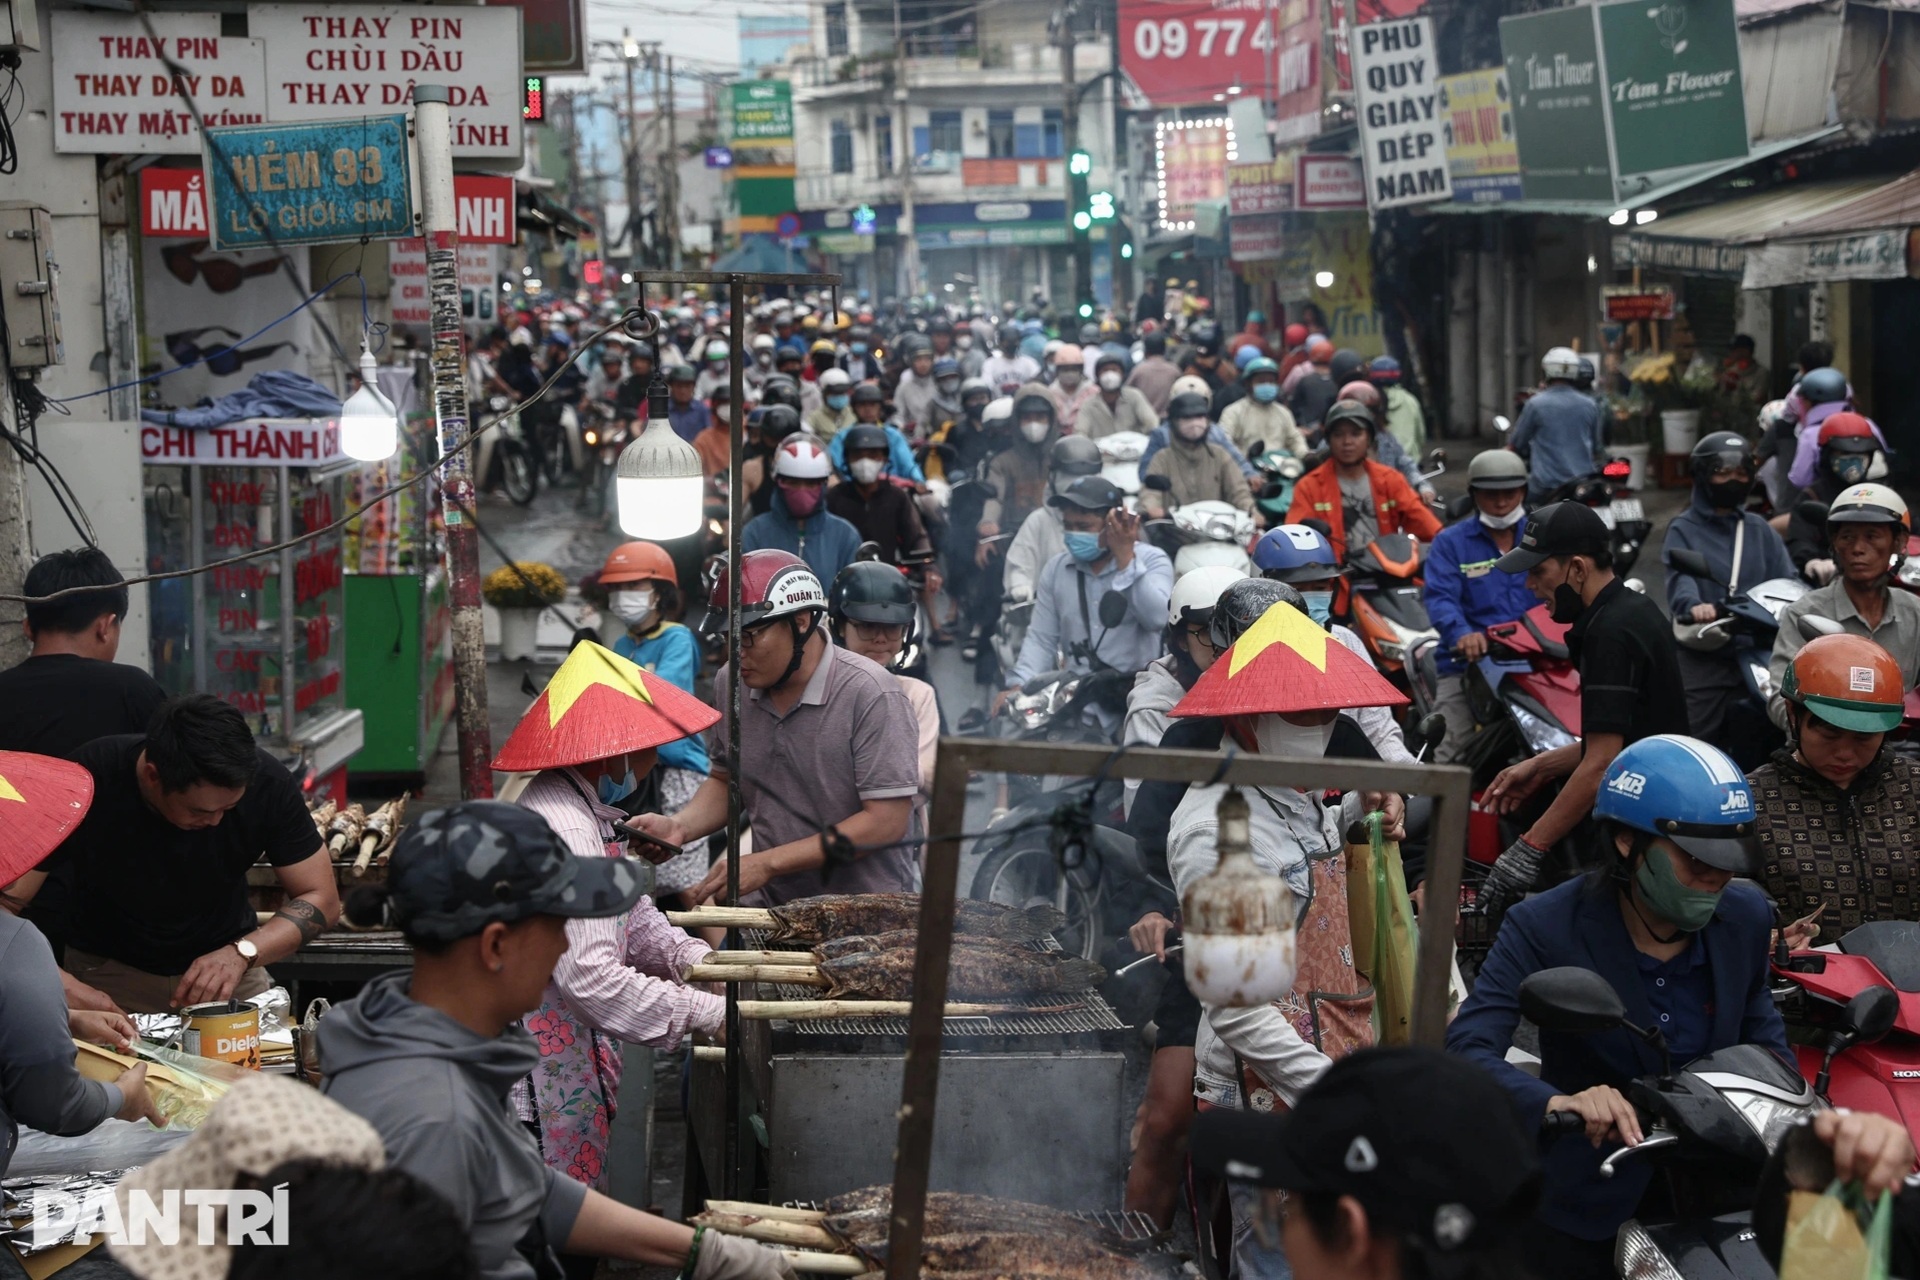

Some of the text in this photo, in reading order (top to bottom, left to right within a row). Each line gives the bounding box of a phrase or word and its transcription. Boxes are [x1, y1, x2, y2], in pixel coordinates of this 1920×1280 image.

[303, 16, 462, 39] THAY PIN
[99, 37, 219, 59] THAY PIN
[306, 41, 463, 72] CHÙI DẦU
[75, 75, 142, 96] THAY
[211, 76, 245, 97] DA
[282, 79, 489, 106] THAY DÂ DA
[1665, 69, 1735, 94] Flower
[61, 112, 128, 135] THAY
[138, 109, 192, 139] MẶT
[449, 118, 509, 146] ÍNH
[232, 140, 383, 192] HẺM 93
[1376, 168, 1446, 201] NAM
[150, 175, 505, 237] MẮ NH
[354, 199, 393, 223] 8M
[209, 424, 319, 459] THÀNH
[209, 482, 264, 505] THAY
[214, 567, 269, 590] THAY
[219, 609, 258, 631] PIN
